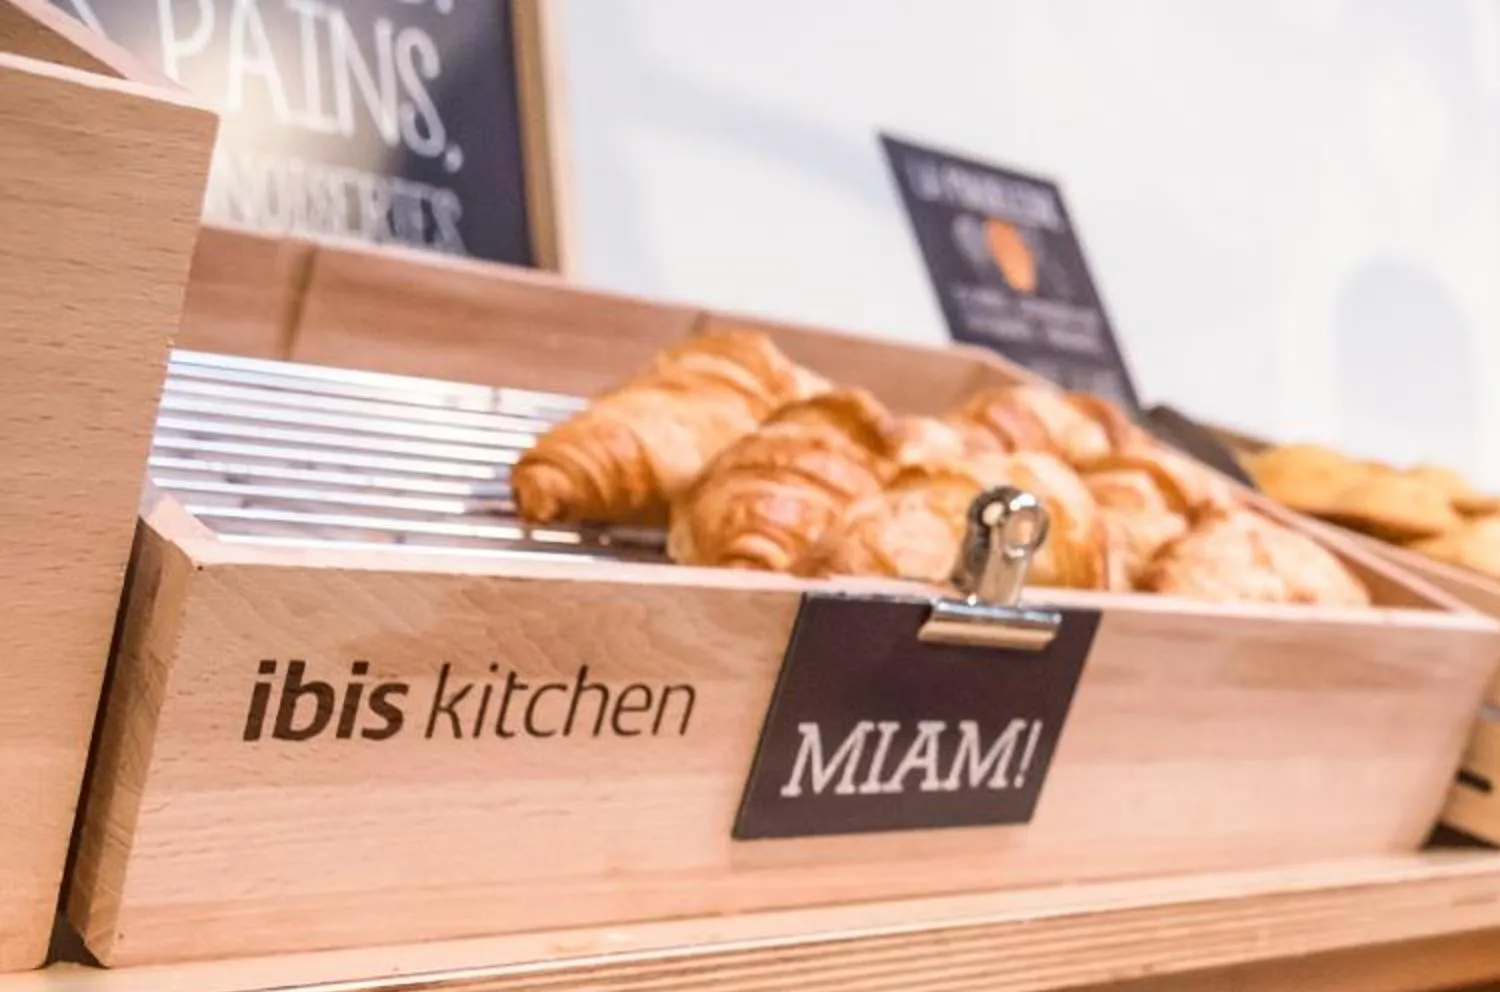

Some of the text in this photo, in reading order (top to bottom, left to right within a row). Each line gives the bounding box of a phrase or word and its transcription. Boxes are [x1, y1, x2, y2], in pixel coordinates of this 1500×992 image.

[243, 659, 697, 741] ibis kitchen
[780, 718, 1043, 797] MIAM!
